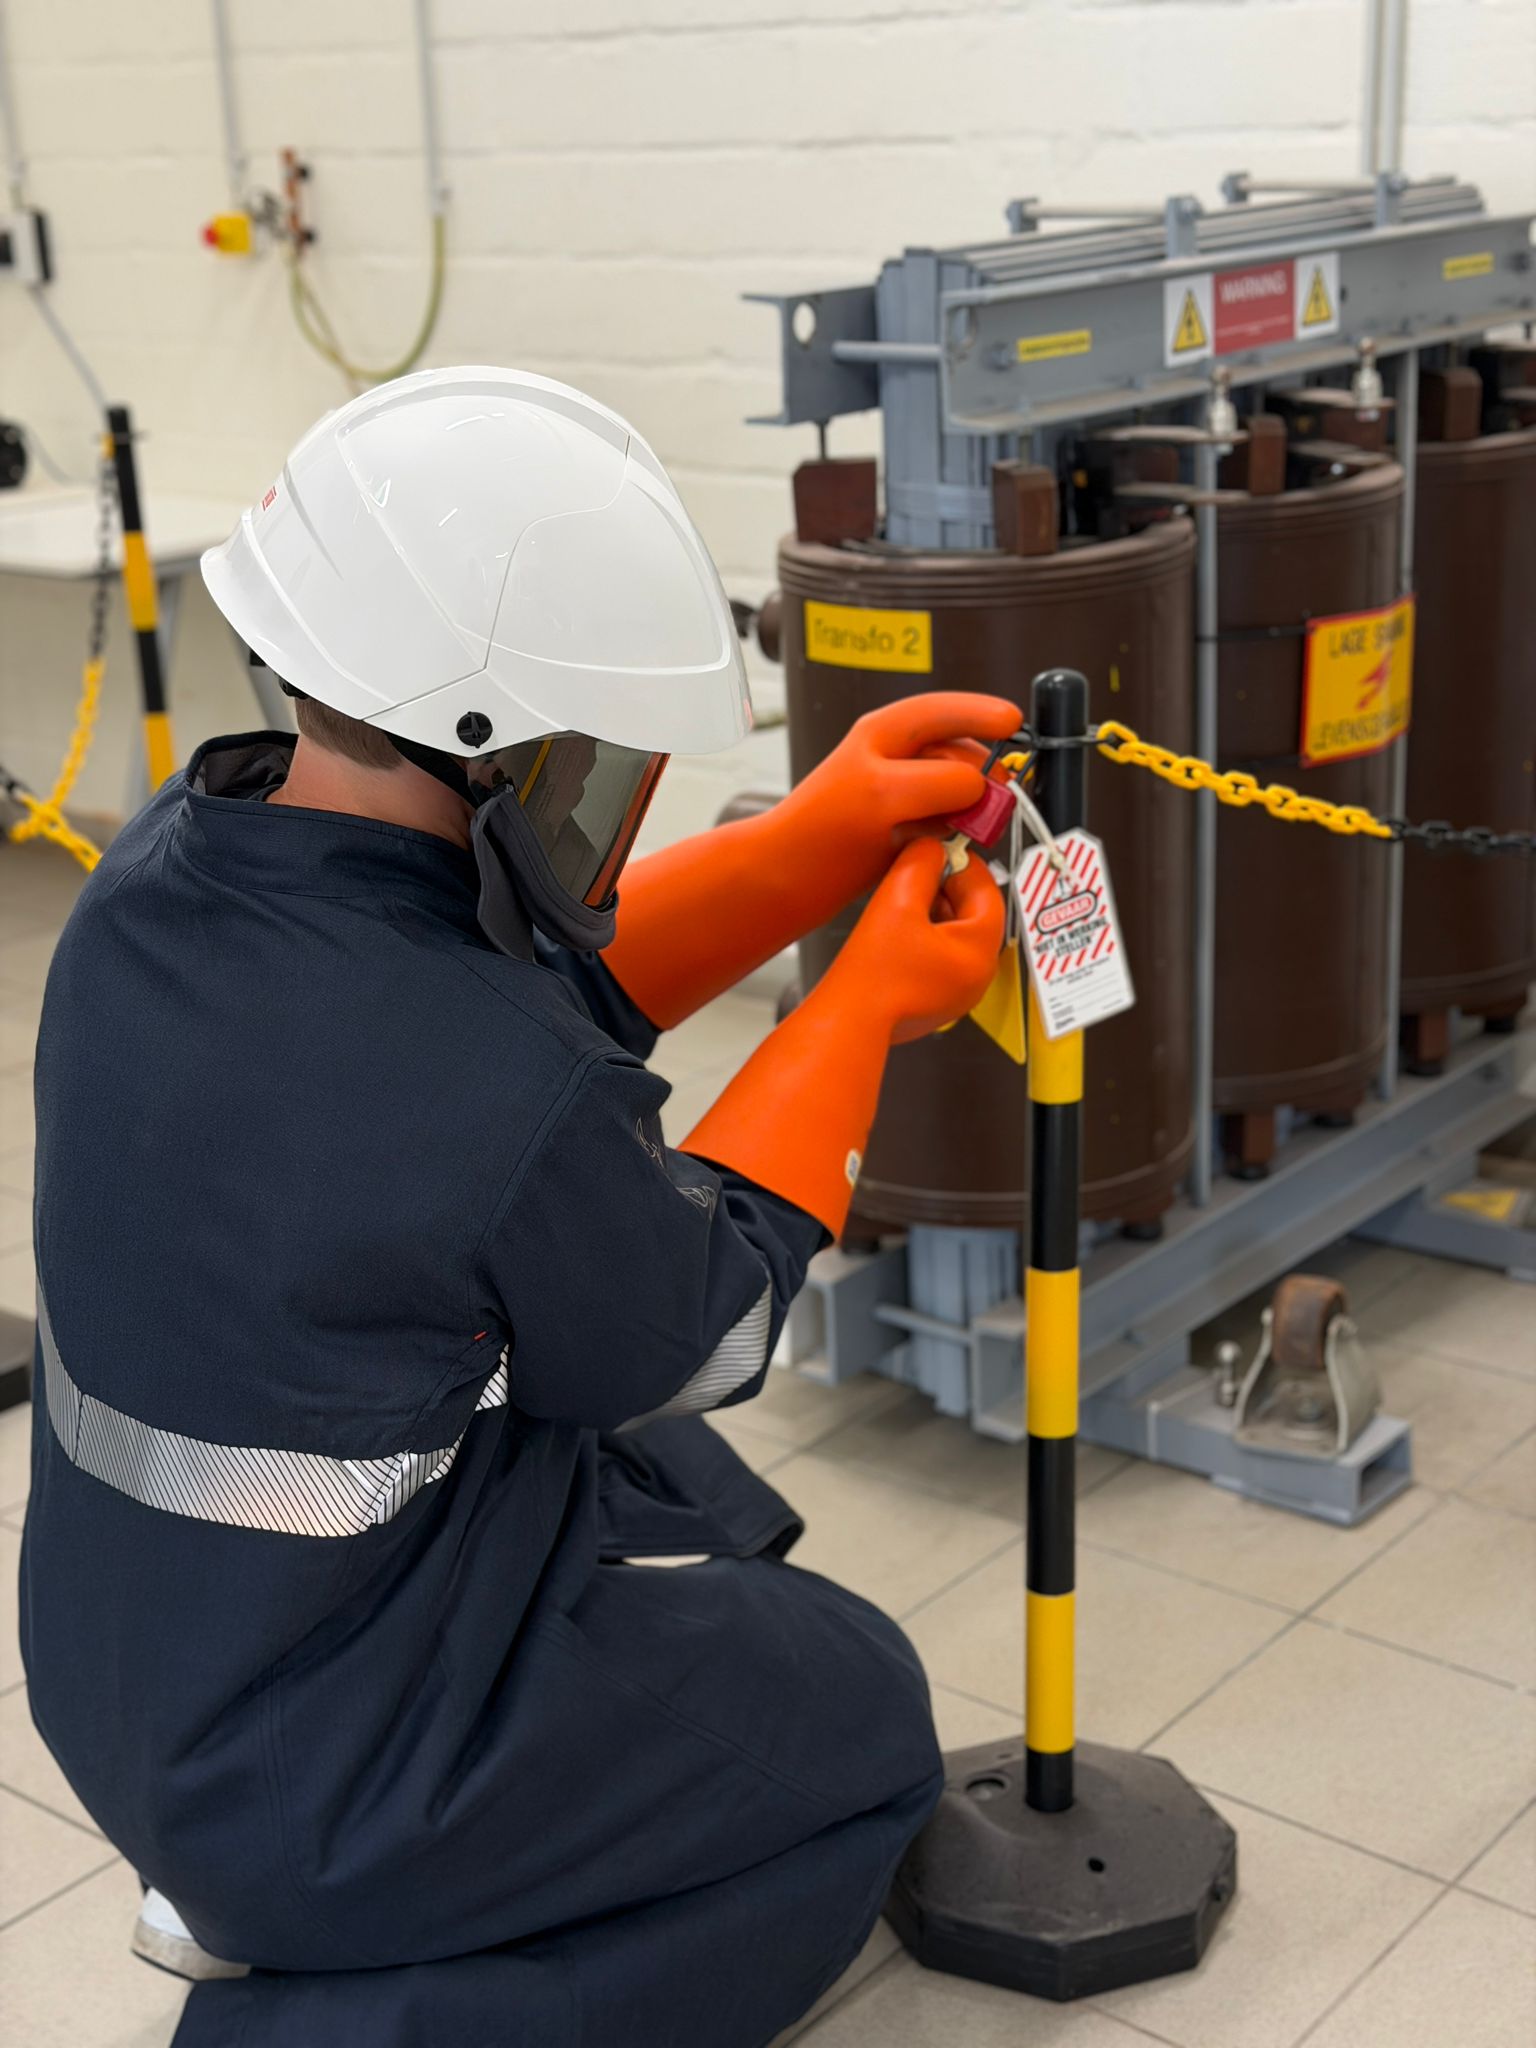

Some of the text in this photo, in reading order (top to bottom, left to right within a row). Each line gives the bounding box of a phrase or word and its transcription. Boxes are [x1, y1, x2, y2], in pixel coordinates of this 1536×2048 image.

[1219, 269, 1288, 305] WARNING
[814, 617, 921, 656] Transfo 2
